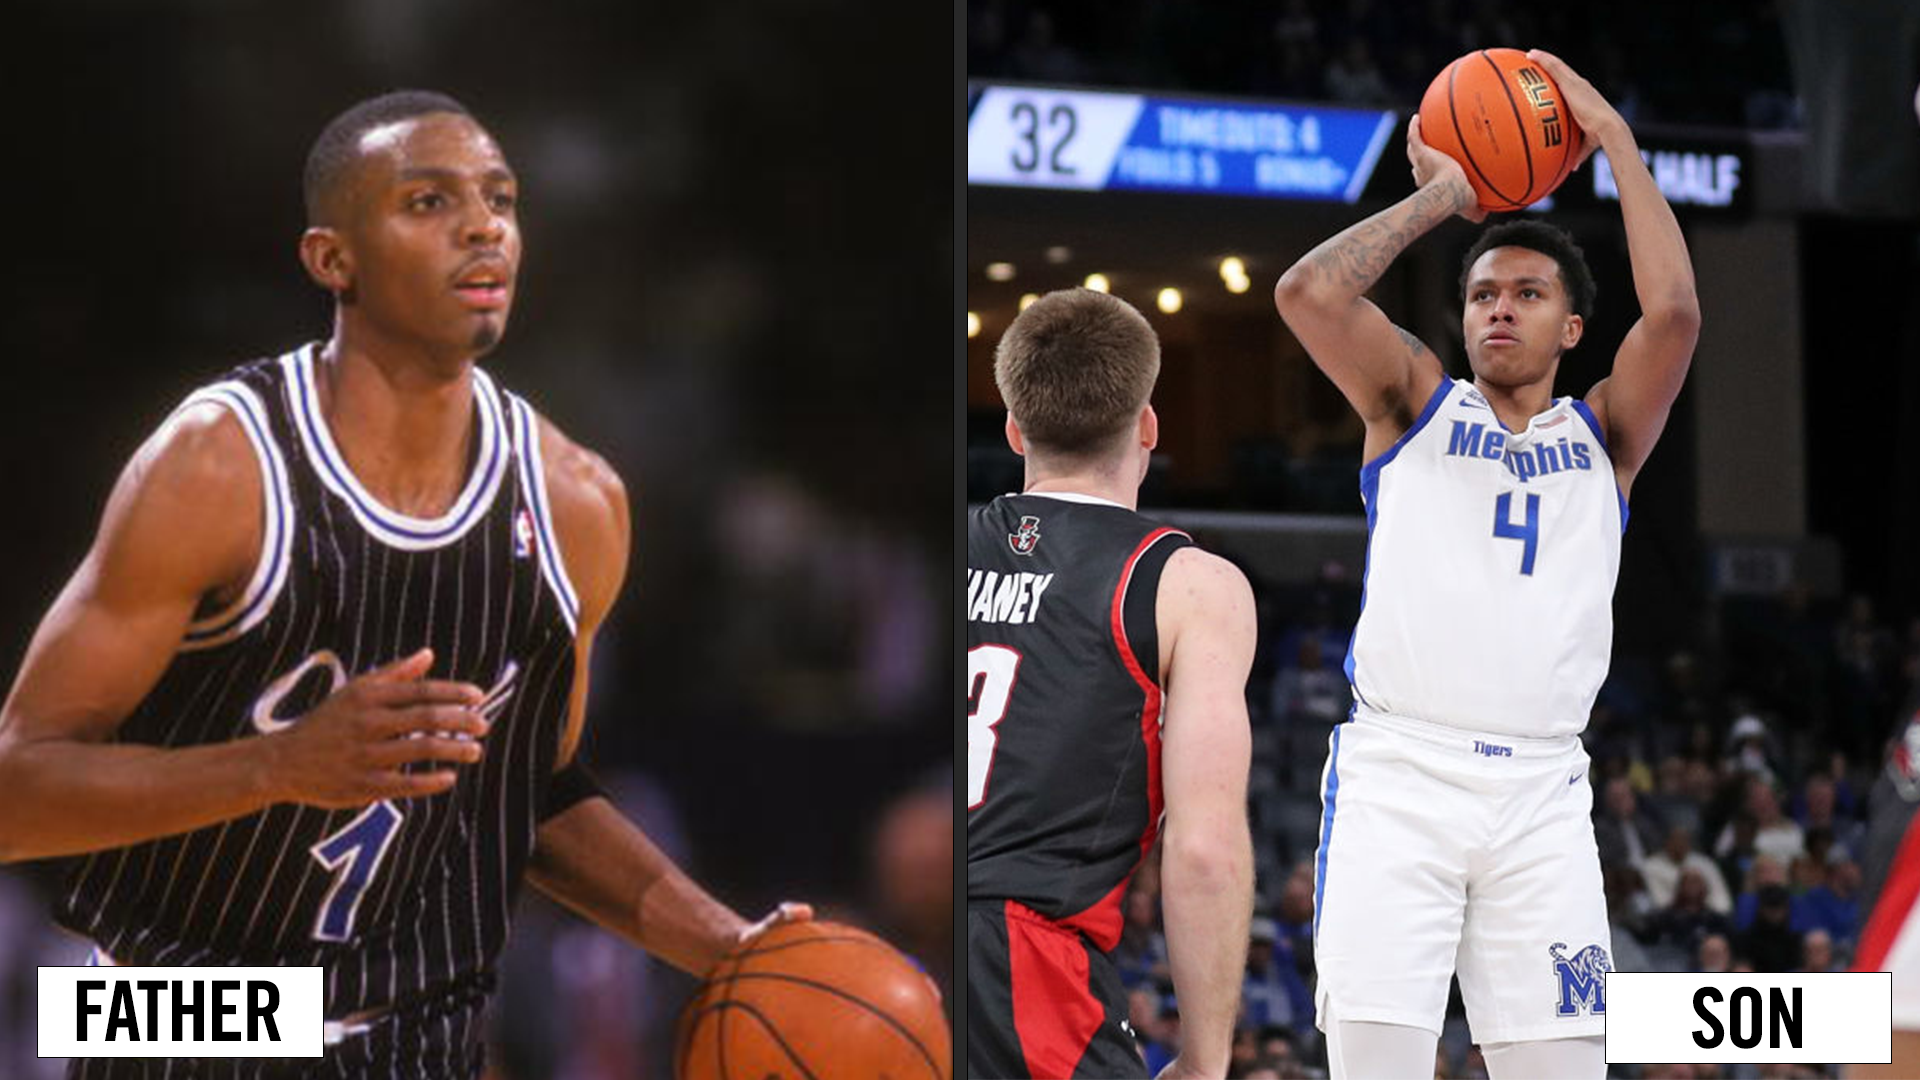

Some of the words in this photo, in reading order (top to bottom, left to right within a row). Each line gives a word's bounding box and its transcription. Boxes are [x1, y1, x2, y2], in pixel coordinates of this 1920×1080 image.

[1010, 101, 1078, 176] 32
[1518, 66, 1562, 149] ELITE
[1654, 151, 1741, 206] HALF
[1493, 491, 1541, 577] 4
[1473, 740, 1514, 758] Tigers
[310, 799, 403, 943] 1
